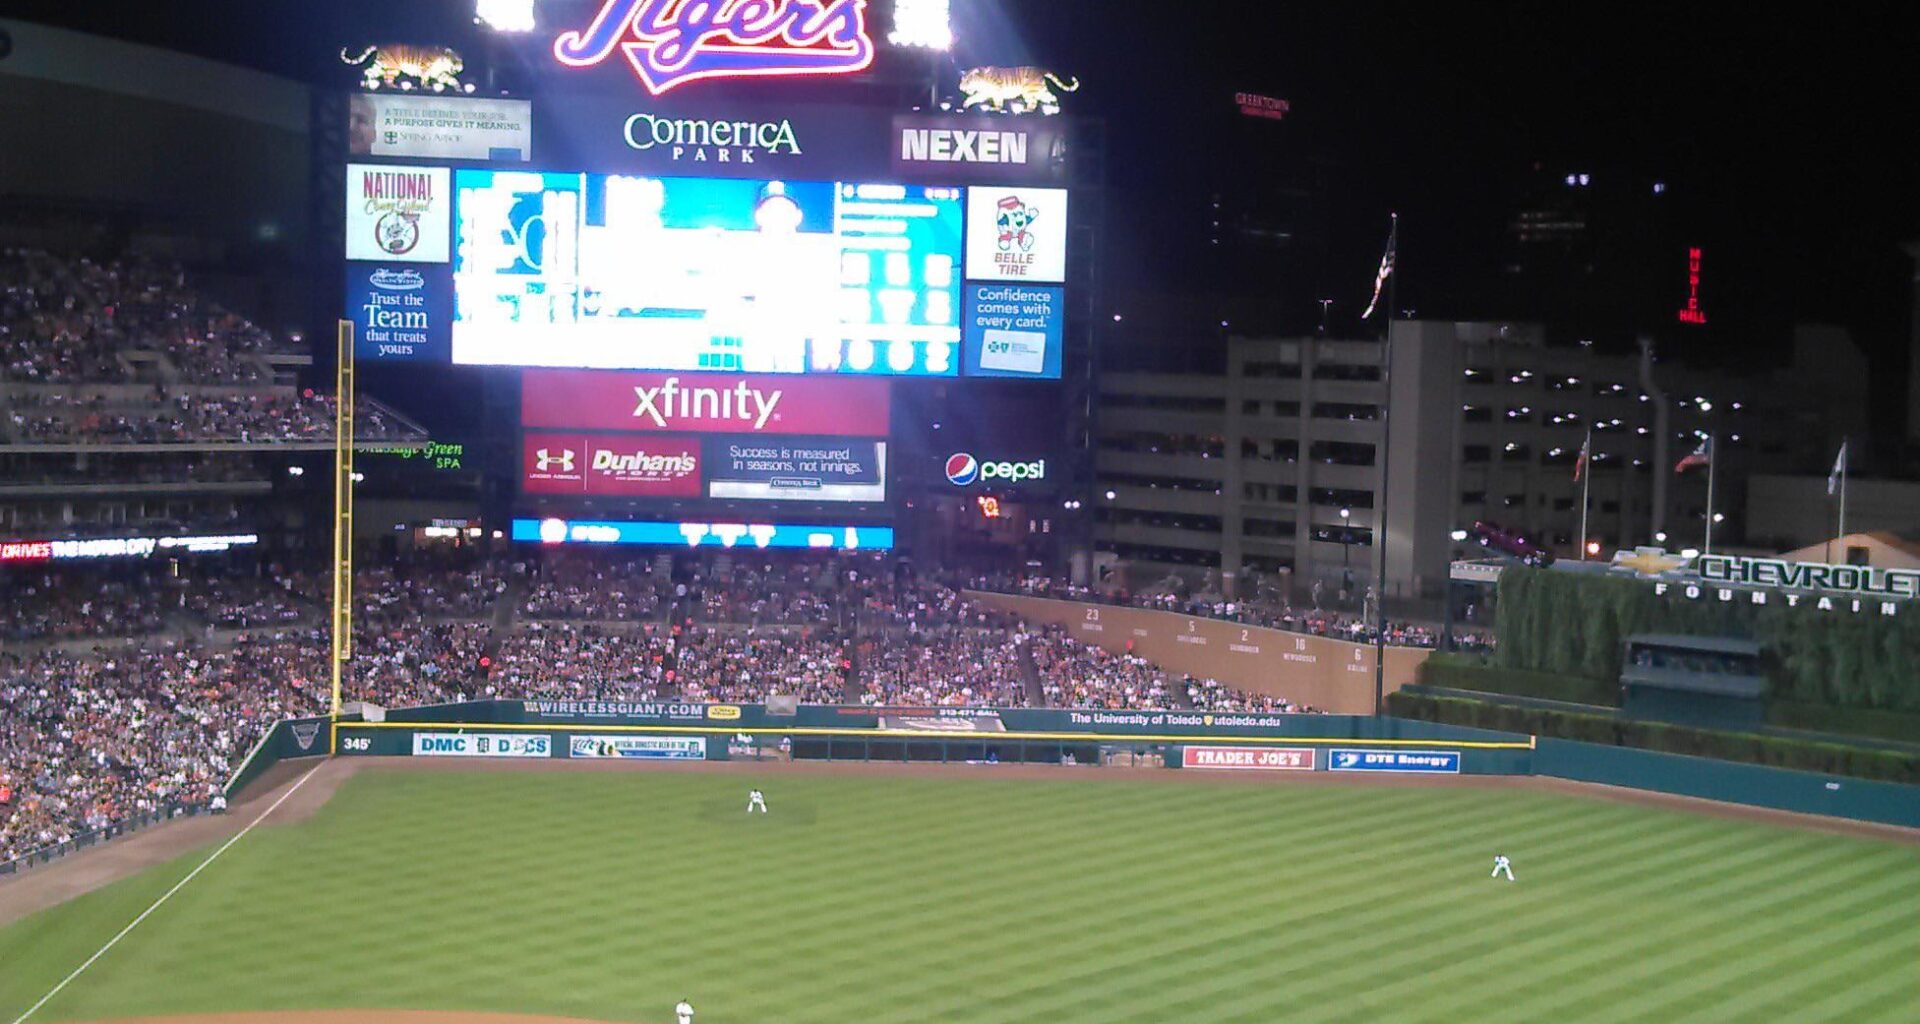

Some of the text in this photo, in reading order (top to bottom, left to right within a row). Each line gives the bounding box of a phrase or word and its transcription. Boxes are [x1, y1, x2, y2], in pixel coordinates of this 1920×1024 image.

[384, 118, 392, 126] A
[393, 118, 433, 127] PURPOSE
[435, 119, 463, 128] GIVES
[464, 120, 474, 129] IT
[902, 129, 1027, 164] NEXEN
[673, 147, 754, 164] PARK
[363, 171, 433, 200] NATIONAL
[994, 252, 1035, 265] BELLE
[998, 264, 1028, 276] TIRE
[1688, 247, 1701, 309] MUSIC
[369, 291, 424, 306] Trust the
[977, 287, 1051, 302] Confidence
[363, 304, 429, 329] Team
[977, 303, 1051, 315] comes with
[1679, 308, 1707, 324] HALL
[976, 316, 1012, 330] every
[366, 329, 427, 343] that treats
[378, 344, 413, 356] yours
[632, 377, 783, 430] xfinity
[423, 441, 463, 459] Green
[729, 445, 850, 460] Success is measured
[436, 457, 461, 469] SPA
[592, 449, 697, 473] Dunham's
[733, 458, 863, 475] in seasons, not innings.
[981, 459, 1045, 482] pepsi
[2, 542, 51, 558] DRIVES
[1699, 554, 1920, 599] CHEVROLE
[1655, 582, 1896, 617] FOUNTAIN
[1086, 608, 1099, 620] 23
[1188, 620, 1195, 632] 5
[1241, 629, 1248, 642] 2
[1354, 648, 1362, 661] 6
[538, 701, 703, 715] WIRELESSGIANT.COM
[1070, 712, 1281, 728] The University of Toledo utoledo.edu
[421, 737, 467, 752] DMC
[1195, 750, 1302, 766] TRADER JOE'S
[1364, 753, 1450, 768] DTE Energy
